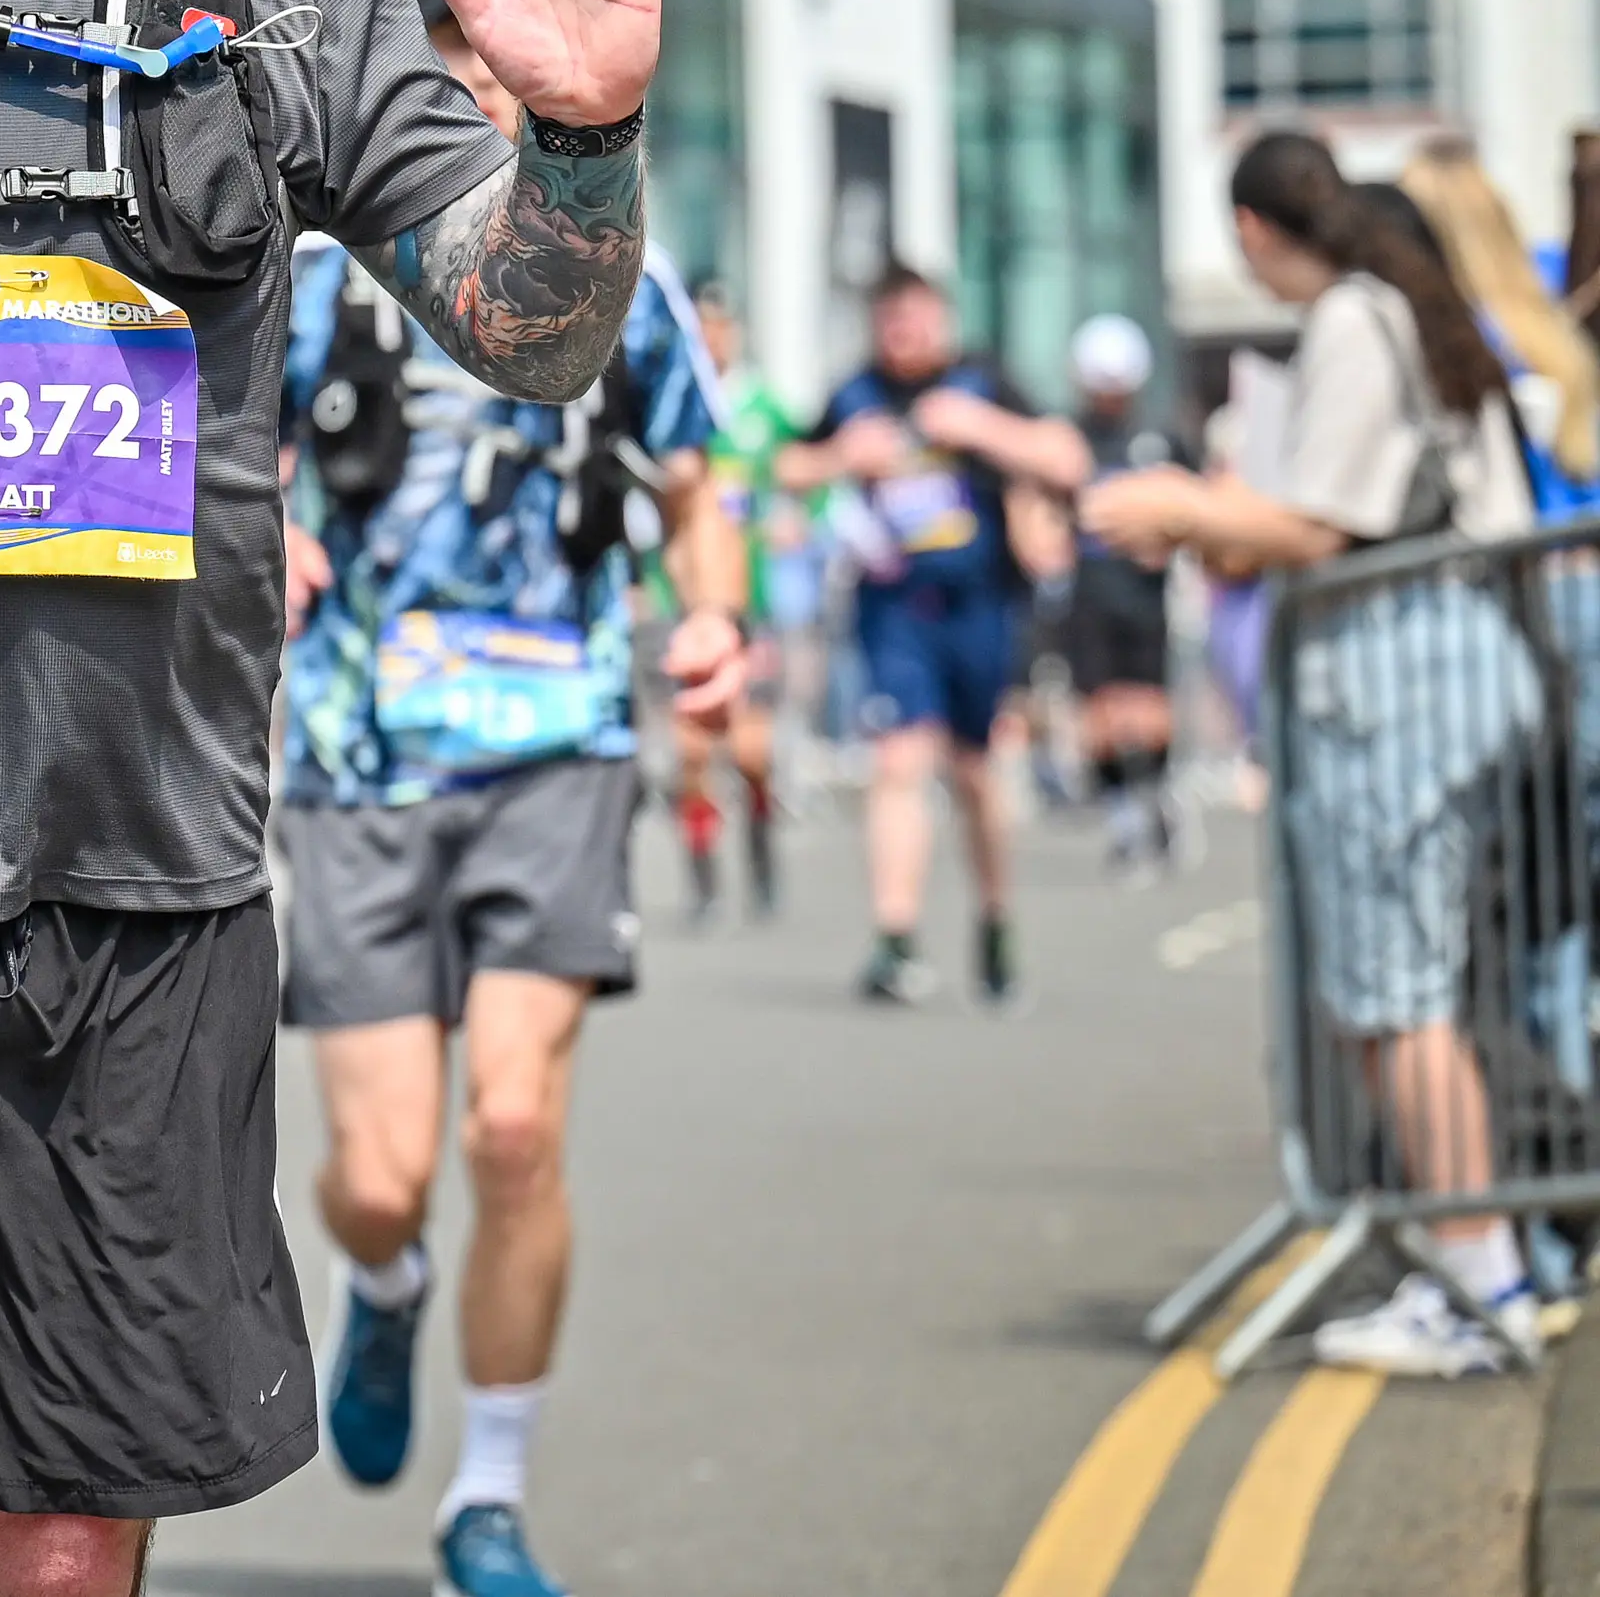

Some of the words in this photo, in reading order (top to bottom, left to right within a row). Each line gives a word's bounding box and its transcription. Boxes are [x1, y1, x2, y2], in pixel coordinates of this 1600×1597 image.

[1, 298, 152, 324] MARATHON
[160, 398, 173, 436] RILEY
[160, 437, 173, 476] MATT
[136, 546, 178, 563] Leeds
